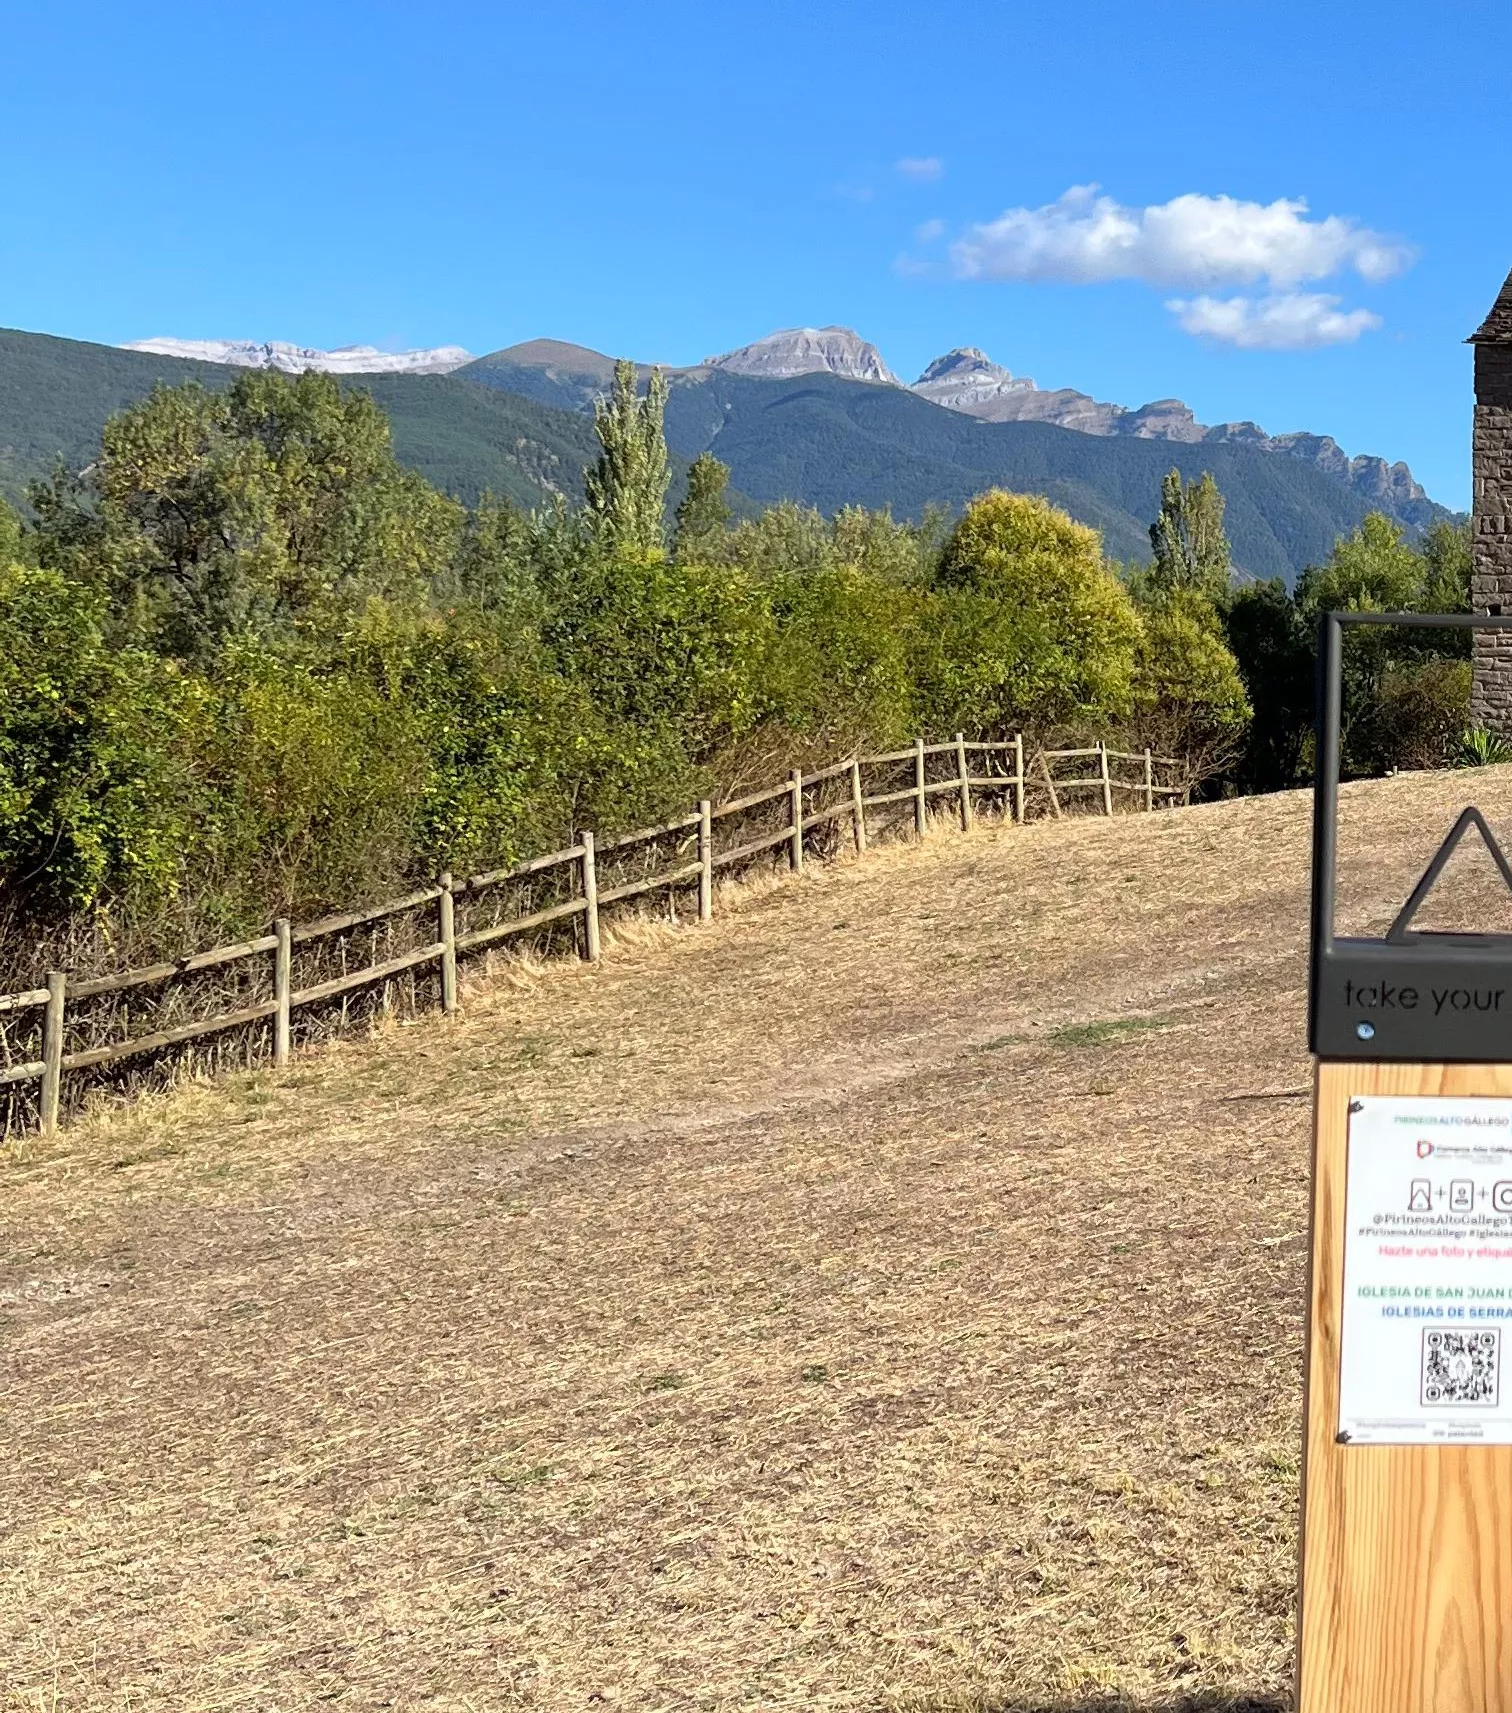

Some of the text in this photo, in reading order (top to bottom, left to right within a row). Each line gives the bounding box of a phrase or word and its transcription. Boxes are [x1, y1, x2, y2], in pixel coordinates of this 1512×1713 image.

[1344, 980, 1418, 1010] take
[1431, 985, 1504, 1016] your
[1378, 1245, 1413, 1256] Hazte
[1416, 1248, 1439, 1257] una
[1440, 1246, 1465, 1257] foto
[1357, 1286, 1411, 1298] IGLESIA
[1414, 1287, 1432, 1299] DE
[1435, 1287, 1463, 1299] SAN
[1467, 1287, 1505, 1300] JUAN
[1381, 1306, 1444, 1318] IGLESIAS
[1447, 1307, 1465, 1319] DE
